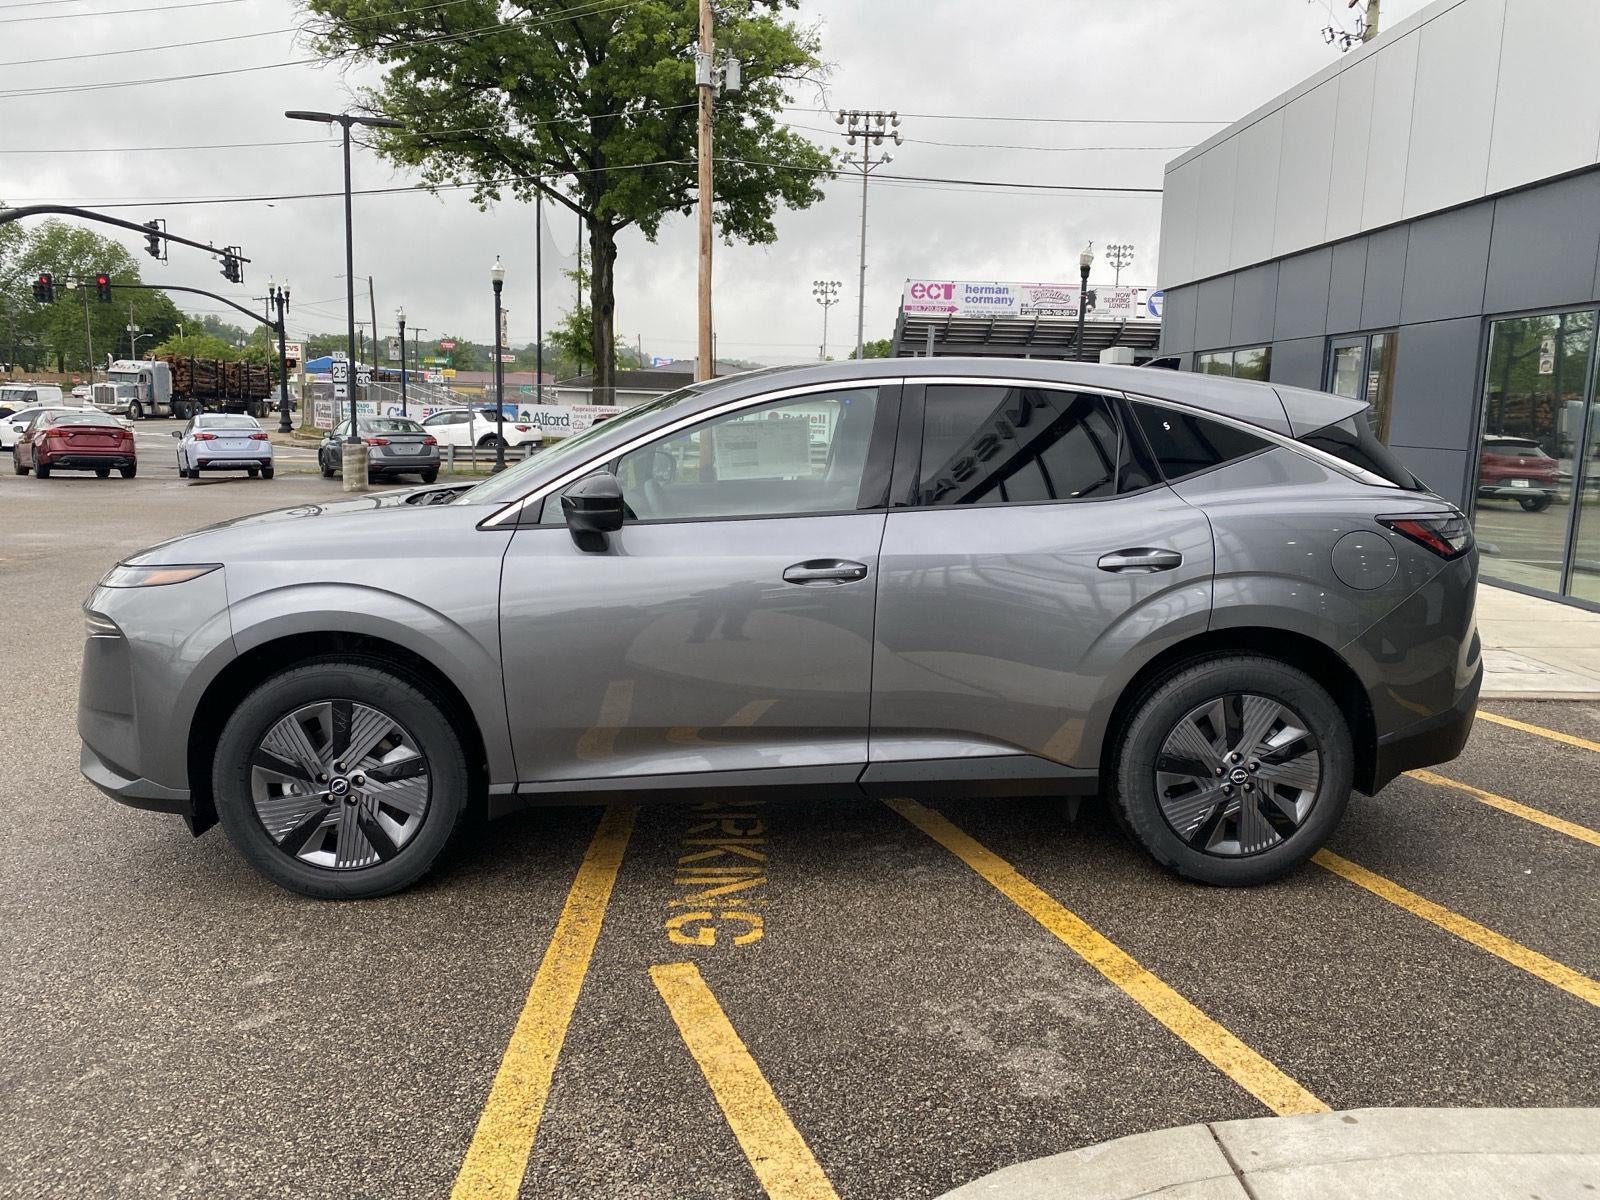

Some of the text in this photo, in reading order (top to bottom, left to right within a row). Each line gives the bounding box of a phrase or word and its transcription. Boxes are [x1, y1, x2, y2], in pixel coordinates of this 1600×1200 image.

[965, 284, 1009, 295] herman
[965, 296, 1015, 306] cormany
[333, 366, 347, 379] 25
[358, 375, 371, 385] 60
[533, 412, 570, 426] Alford
